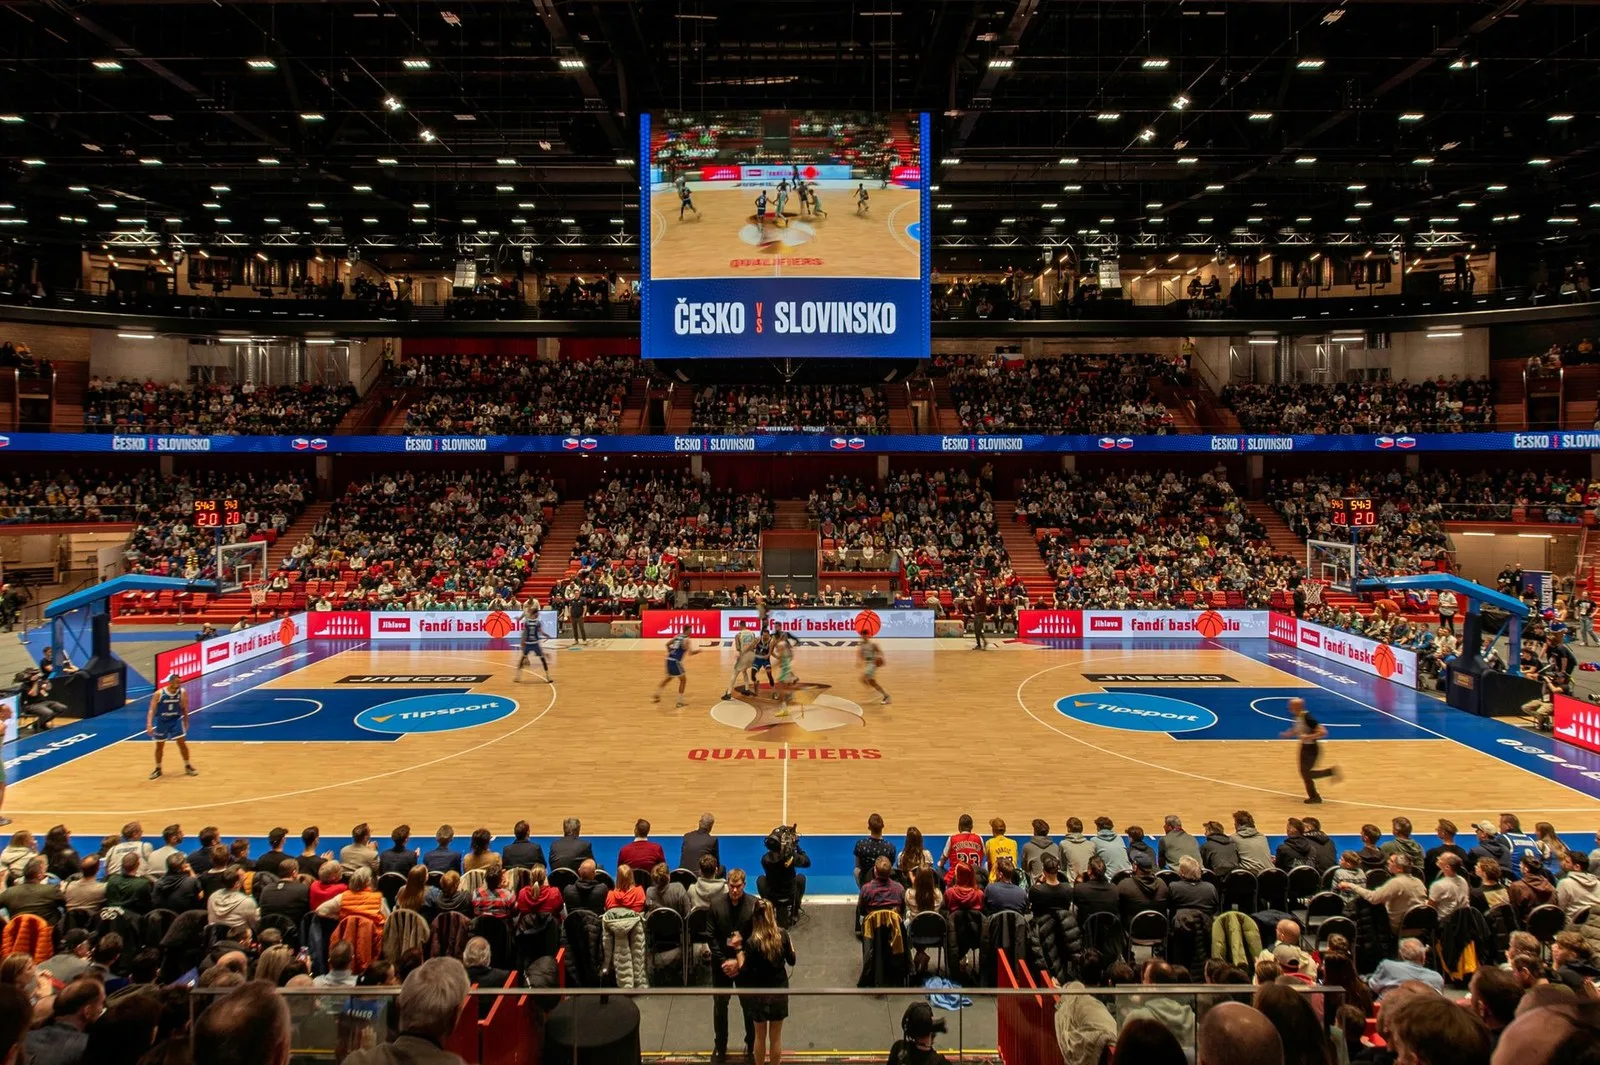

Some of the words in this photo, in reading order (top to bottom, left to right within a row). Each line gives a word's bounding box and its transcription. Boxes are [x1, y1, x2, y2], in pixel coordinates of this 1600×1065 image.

[675, 297, 745, 335] ČESKO
[775, 301, 896, 334] SLOVINSKO
[112, 436, 146, 451] ČESKO
[157, 438, 210, 451] SLOVINSKO
[405, 436, 432, 451] ČESKO
[441, 438, 487, 451] SLOVINSKO
[674, 436, 701, 450] ČESKO
[710, 438, 755, 450] SLOVINSKO
[942, 436, 968, 450] ČESKO
[978, 438, 1023, 450] SLOVINSKO
[1211, 435, 1238, 450] ČESKO
[1247, 438, 1293, 450] SLOVINSKO
[1514, 433, 1549, 448] ČESKO
[198, 513, 217, 525] 20
[1354, 512, 1374, 525] 20
[382, 620, 407, 629] Jihlava
[420, 619, 452, 632] fandí
[769, 618, 802, 631] fndí
[1094, 619, 1119, 628] Jihlava
[1131, 618, 1164, 631] fandí
[1323, 635, 1346, 656] fandí
[399, 701, 500, 720] Tipsport
[1096, 703, 1200, 722] Tipsport
[687, 748, 882, 761] QUALIFIERS
